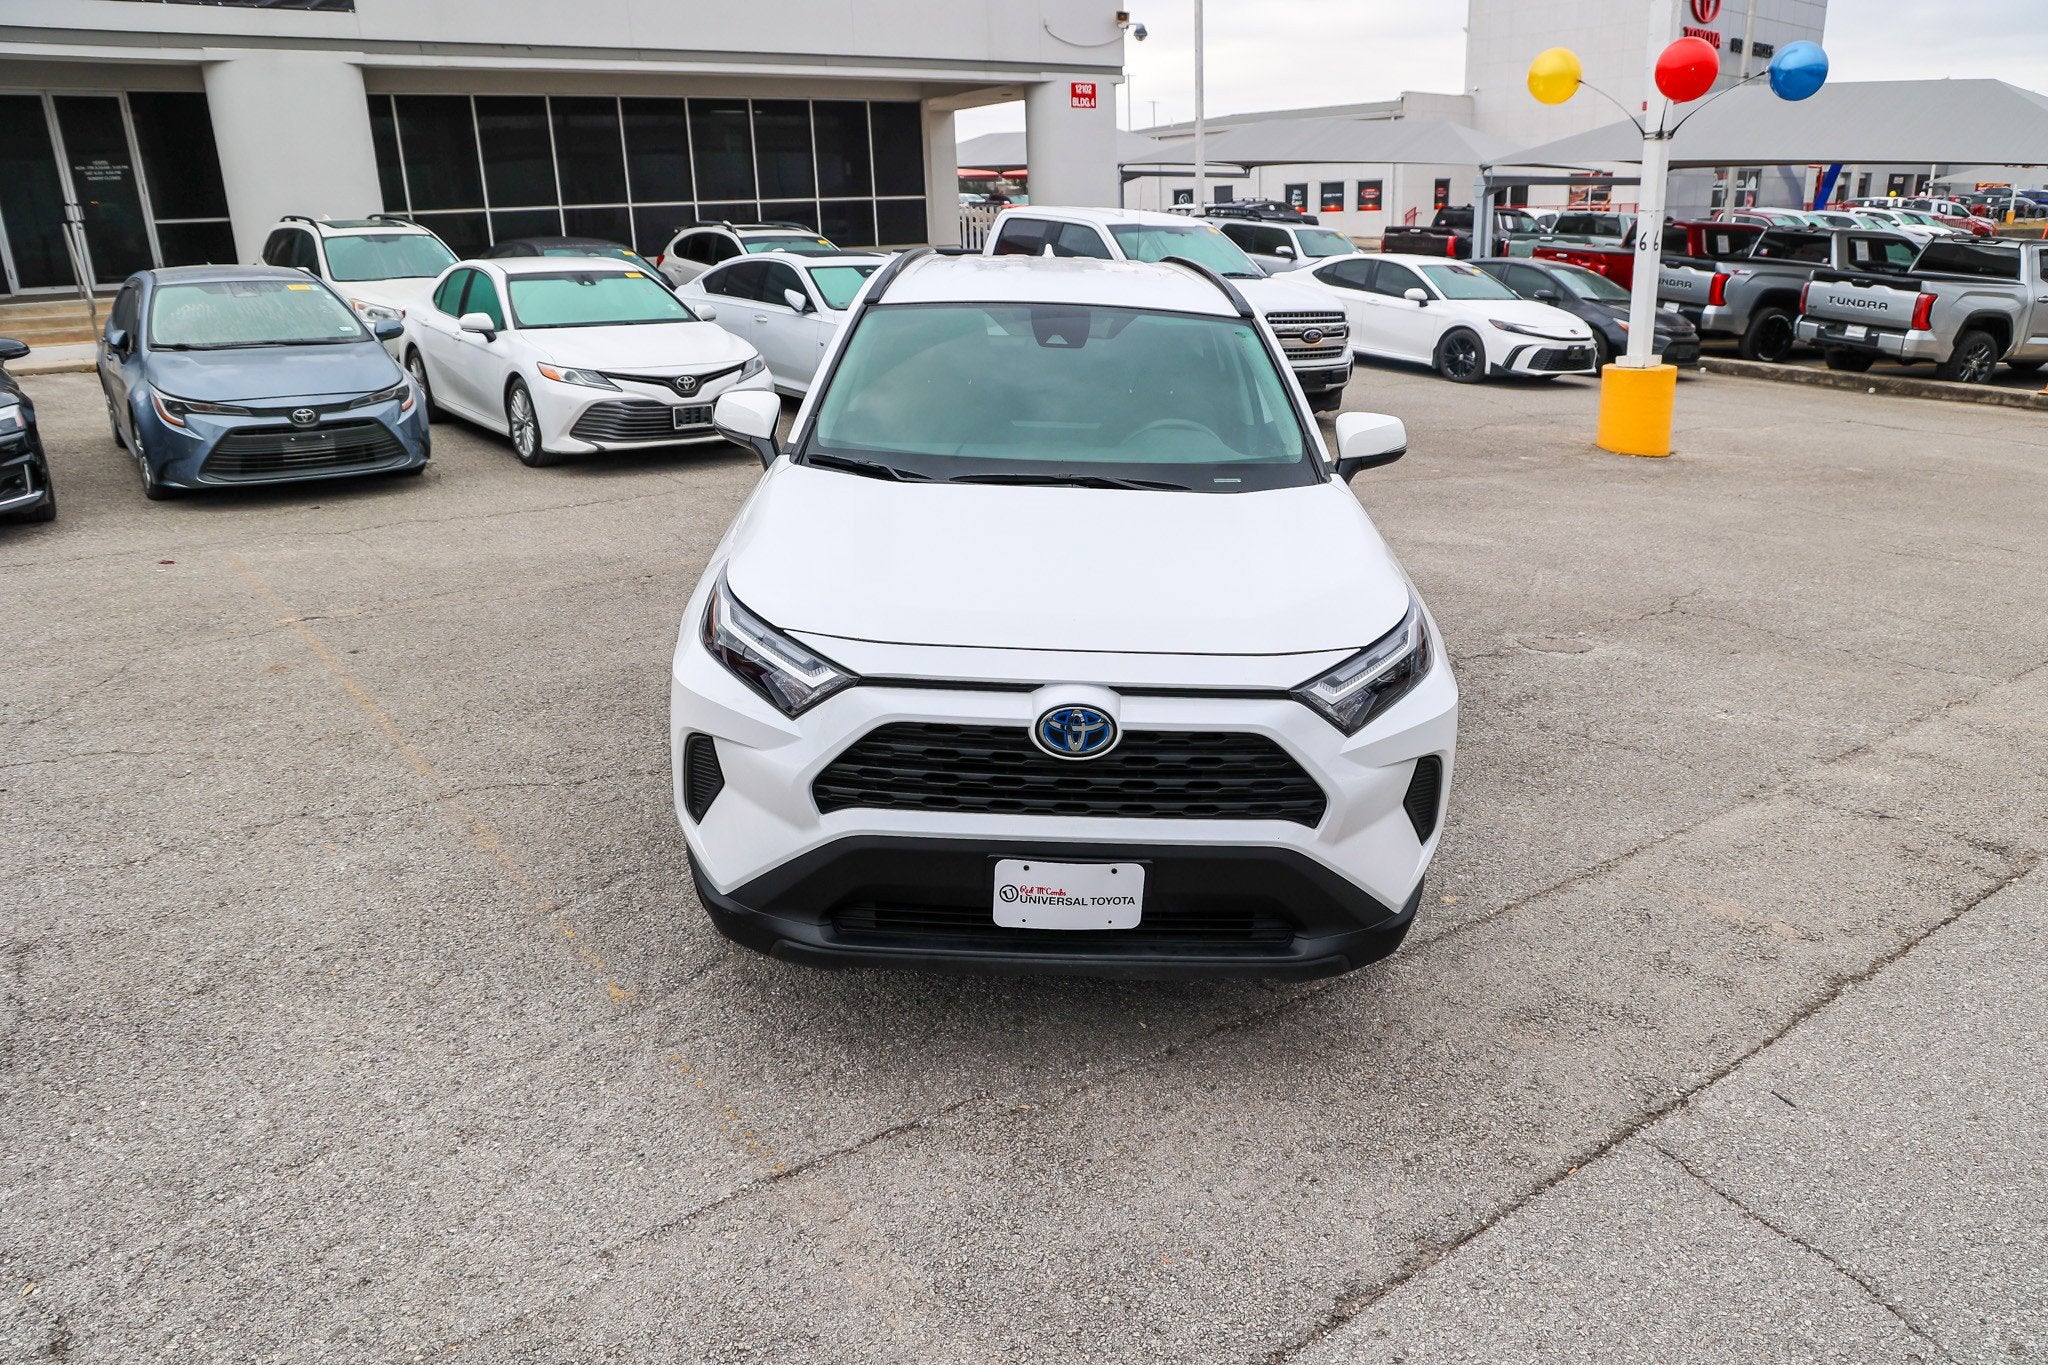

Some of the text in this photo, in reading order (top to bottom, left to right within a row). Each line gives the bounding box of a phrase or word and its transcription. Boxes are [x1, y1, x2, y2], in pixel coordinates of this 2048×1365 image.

[1828, 295, 1888, 310] TUNDRA
[1020, 884, 1034, 896] Red
[1020, 895, 1136, 906] UNIVERSAL TOYOTA
